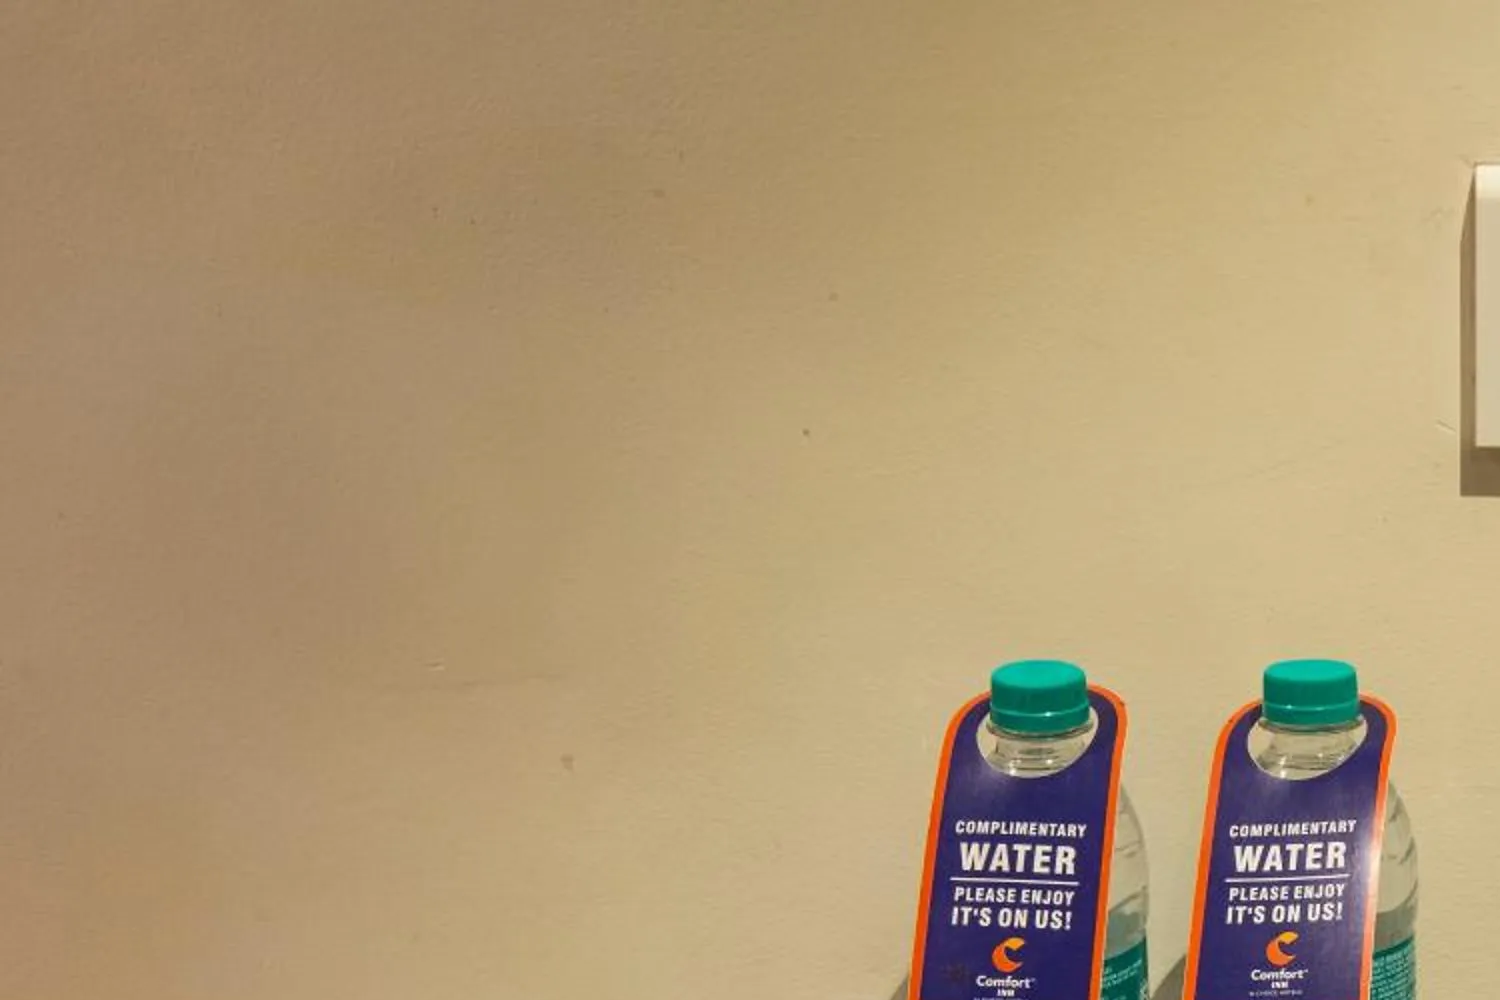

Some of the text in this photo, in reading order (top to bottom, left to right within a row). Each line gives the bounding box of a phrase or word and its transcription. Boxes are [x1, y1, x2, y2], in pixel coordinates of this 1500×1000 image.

[955, 820, 1087, 838] COMPLIMENTARY
[1229, 820, 1357, 838] COMPLIMENTARY
[960, 842, 1077, 875] WATER
[1233, 841, 1347, 873] WATER
[954, 886, 1075, 906] PLEASE ENJOY
[1229, 883, 1345, 902] PLEASE ENJOY
[951, 906, 1073, 931] IT'S ON US!
[1226, 901, 1343, 925] IT'S ON US!
[976, 975, 1031, 989] Comfort
[1251, 967, 1305, 981] Comfort
